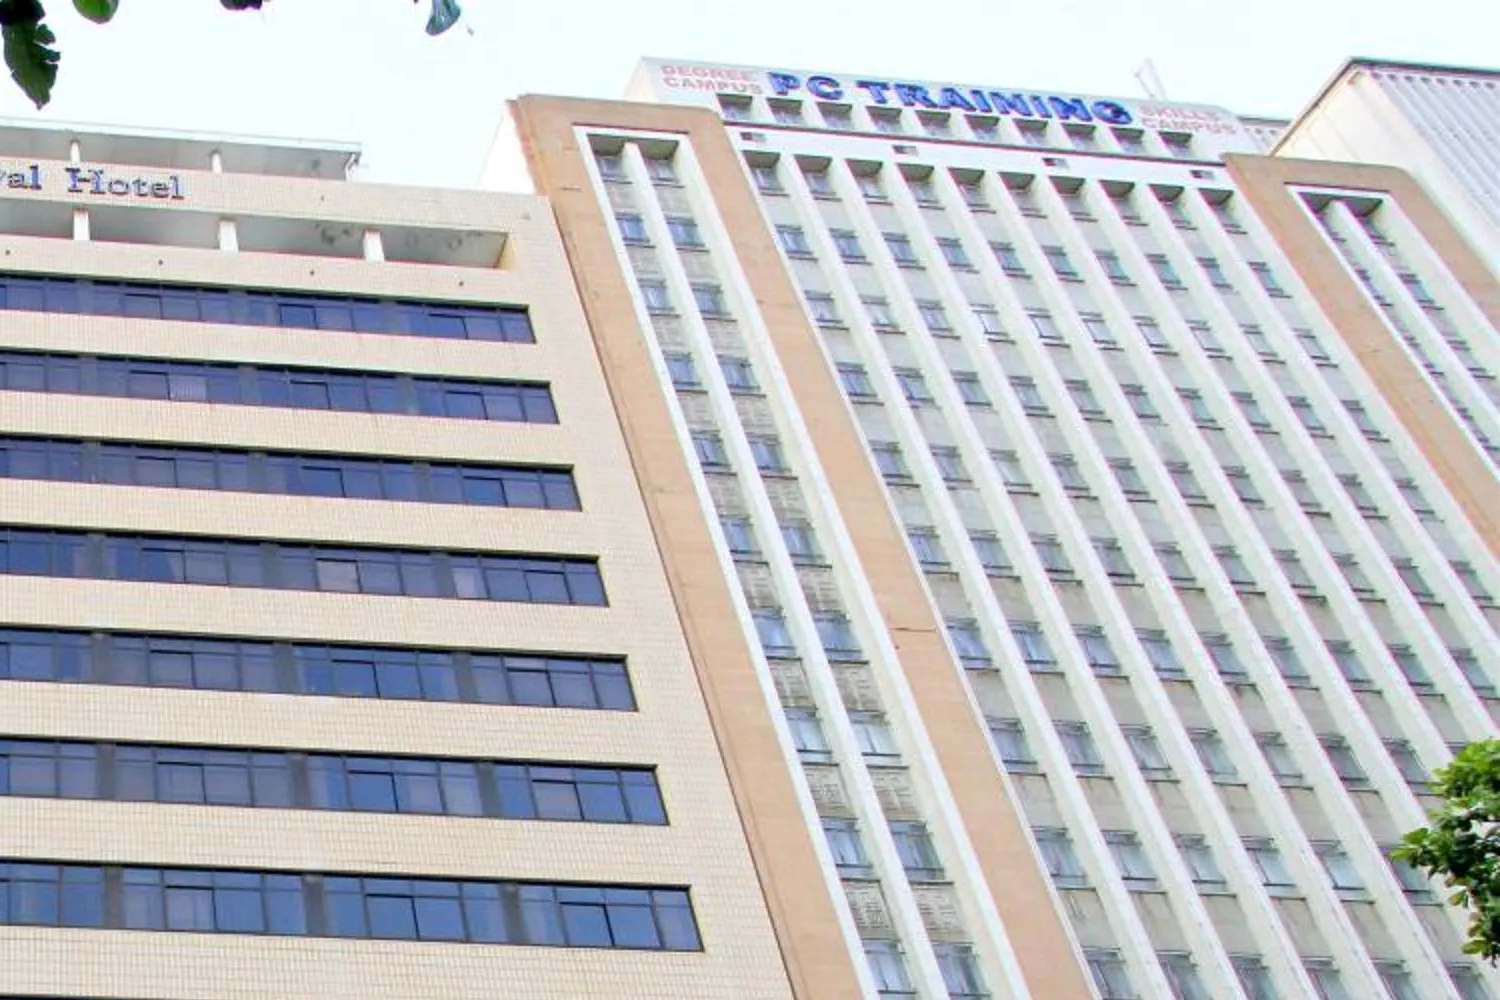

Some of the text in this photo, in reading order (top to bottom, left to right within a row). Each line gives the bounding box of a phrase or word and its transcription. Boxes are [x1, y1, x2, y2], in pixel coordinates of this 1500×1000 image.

[663, 77, 764, 95] CAMPUS
[767, 71, 1133, 125] PC TRAINING
[1141, 117, 1236, 134] CAMPUS
[66, 166, 185, 200] Hotel
